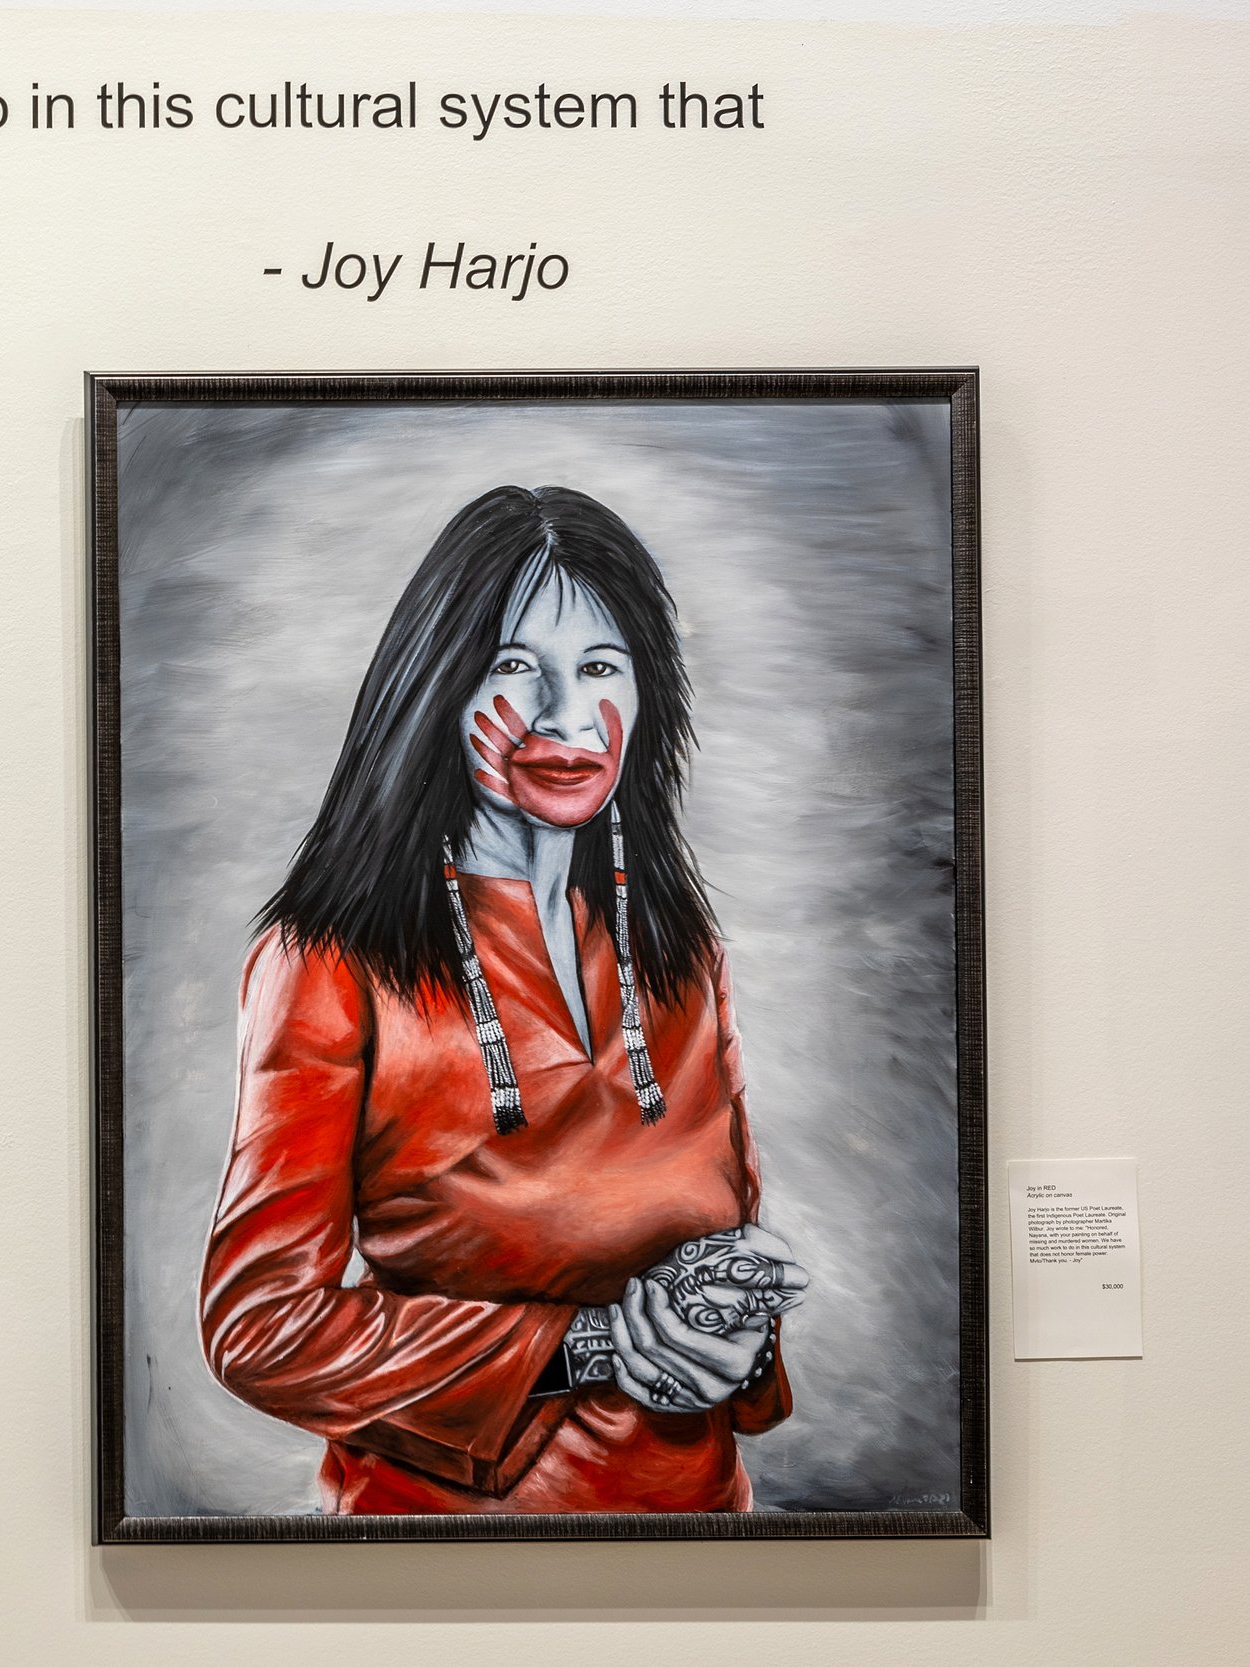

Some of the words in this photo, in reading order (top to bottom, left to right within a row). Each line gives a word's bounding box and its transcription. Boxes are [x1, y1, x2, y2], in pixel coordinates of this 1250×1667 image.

[33, 82, 75, 129] in
[97, 81, 194, 129] this
[216, 81, 416, 129] cultural
[440, 82, 637, 141] system
[659, 81, 765, 129] that
[263, 267, 283, 275] -
[301, 241, 404, 302] Joy
[419, 242, 570, 302] Harjo
